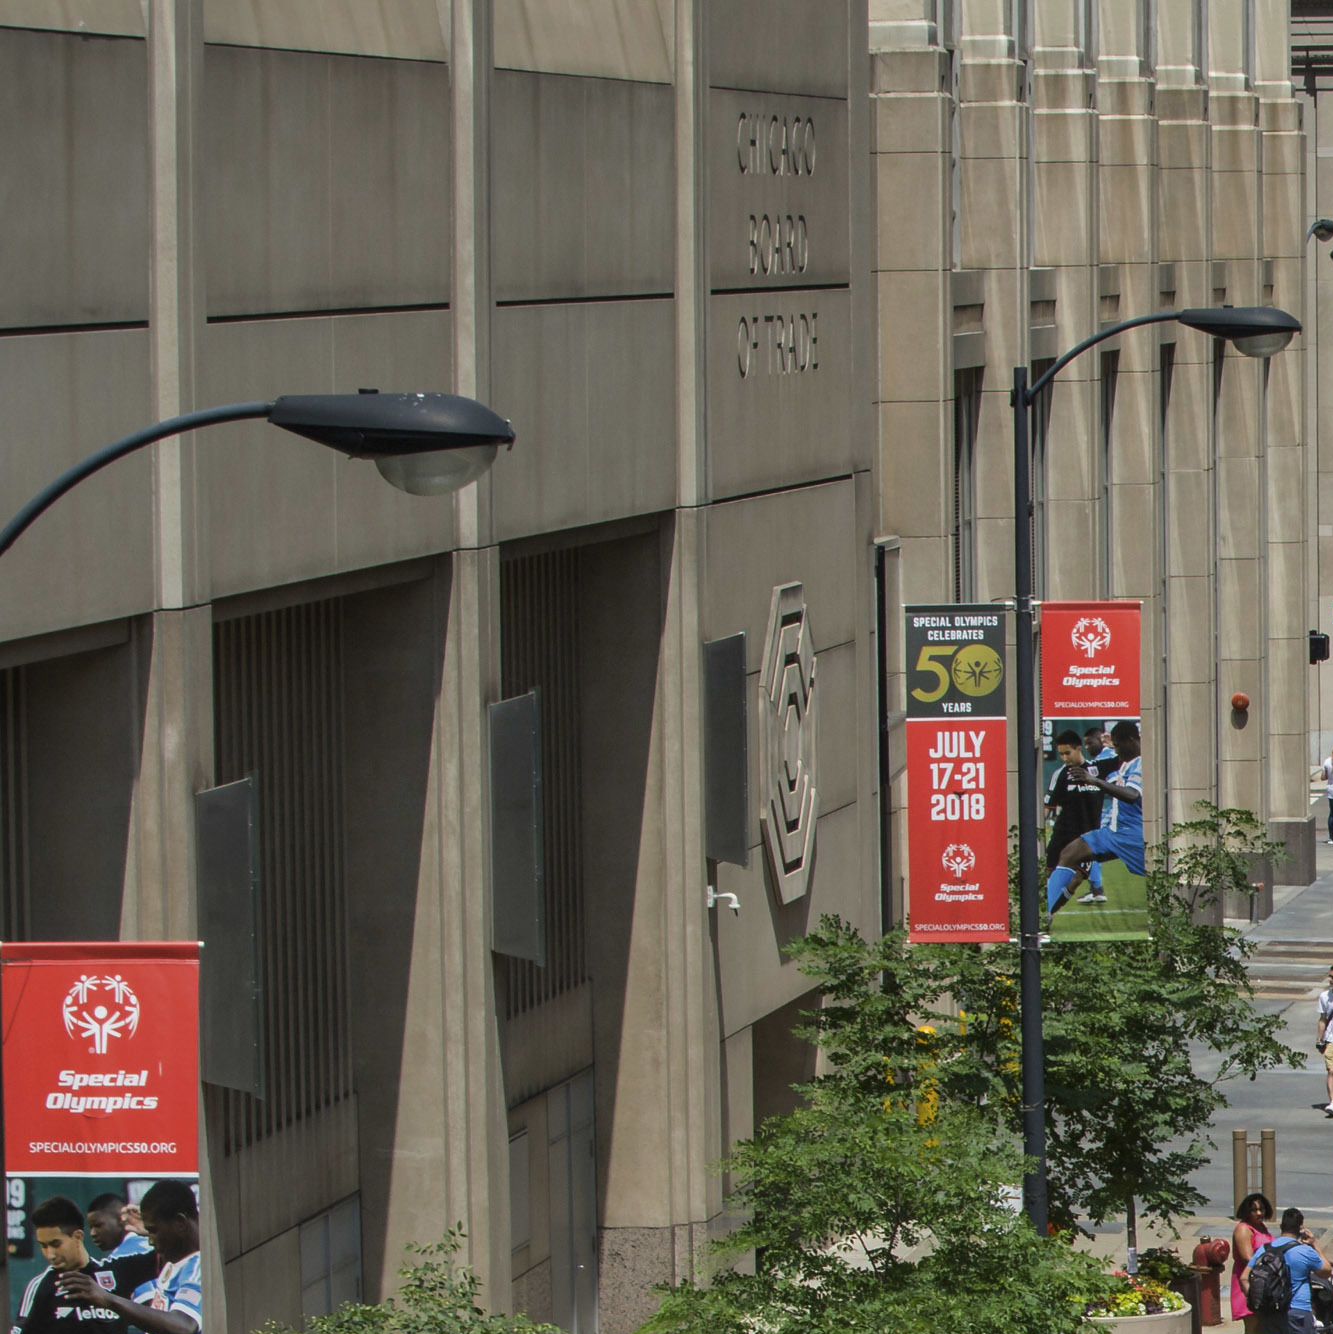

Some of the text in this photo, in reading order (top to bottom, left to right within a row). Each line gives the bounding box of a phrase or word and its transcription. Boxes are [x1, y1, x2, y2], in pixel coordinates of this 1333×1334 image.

[737, 113, 817, 176] CHICAGO
[748, 214, 809, 275] BOARD
[737, 314, 821, 378] OF TRADE
[913, 616, 998, 627] SPECIAL OLYMPICS
[927, 630, 984, 641] CELEBRATES
[1069, 665, 1115, 676] Special
[1062, 676, 1120, 688] Olympics
[942, 703, 972, 713] YEARS
[929, 731, 986, 758] JULY
[930, 762, 985, 789] 17-21
[931, 794, 985, 821] 2018
[939, 883, 979, 893] Special
[934, 892, 984, 902] Olympics
[58, 1070, 147, 1089] Special
[46, 1092, 159, 1113] Olympics
[29, 1142, 177, 1154] SPECIALOLYMPICS50.ORG
